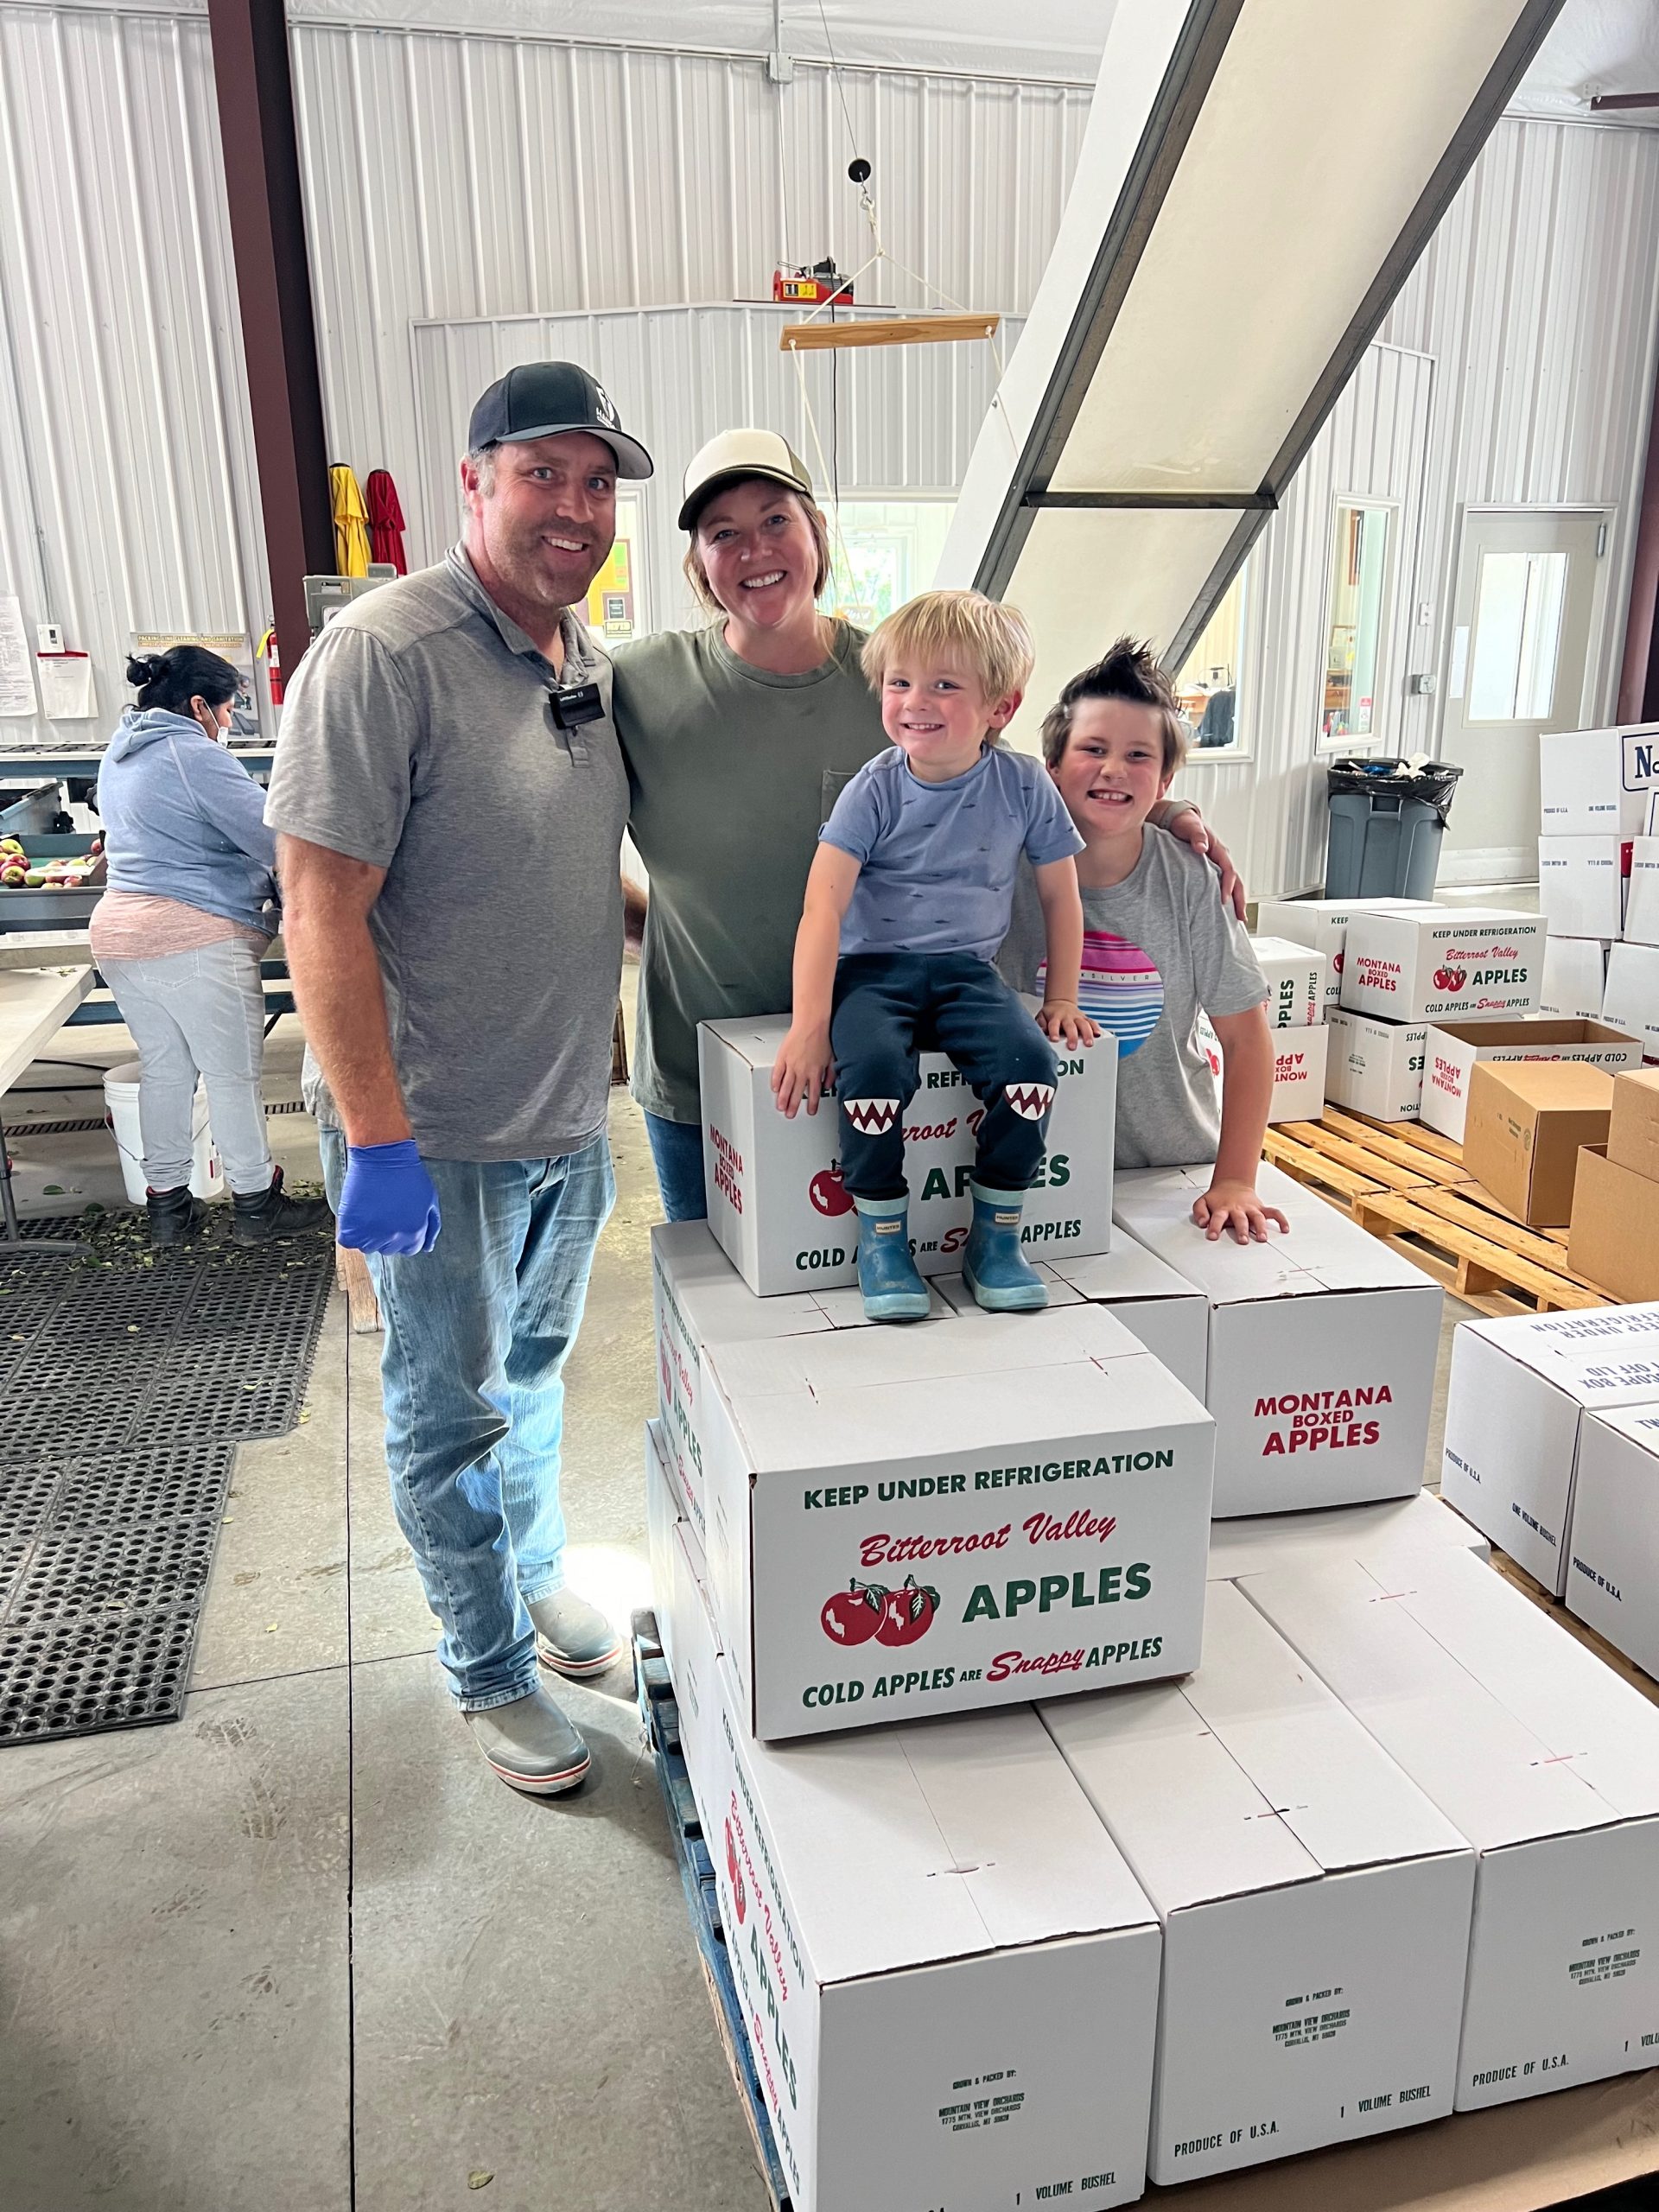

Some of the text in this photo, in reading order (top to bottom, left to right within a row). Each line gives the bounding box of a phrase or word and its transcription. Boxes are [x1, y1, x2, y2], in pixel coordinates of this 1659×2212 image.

[1433, 926, 1536, 938] KEEP UNDER REFRIGERATION
[1357, 957, 1401, 973] MONTANA
[1446, 946, 1519, 961] Bitterroot Valley
[1358, 974, 1397, 992] APPLES
[1368, 969, 1388, 978] BOXED
[1472, 968, 1528, 985] APPLES
[1308, 972, 1317, 1001] APPLES
[1425, 1004, 1443, 1013] COLD
[1445, 1002, 1469, 1011] APPLES
[1506, 998, 1530, 1007] APPLES
[1435, 1057, 1461, 1079] APPLES
[1572, 1053, 1603, 1063] APPLES
[1605, 1053, 1627, 1062] COLD
[1432, 1074, 1462, 1098] MONTANA
[710, 1123, 744, 1176] MONTANA
[715, 1162, 743, 1214] APPLES
[795, 1248, 845, 1271] COLD
[920, 1241, 938, 1252] ARE
[1021, 1219, 1082, 1244] APPLES
[1578, 1378, 1618, 1389] BOX
[1254, 1385, 1392, 1417] MONTANA
[1293, 1410, 1354, 1428] BOXED
[1262, 1421, 1380, 1456] APPLES
[1446, 1448, 1463, 1469] PRODUCE
[1463, 1462, 1469, 1472] OF
[804, 1449, 1174, 1510] KEEP UNDER REFRIGERATION
[860, 1508, 1117, 1567] Bitterroot Valley
[1512, 1503, 1557, 1548] ONE VOLUME BUSHEL
[1573, 1556, 1622, 1602] PRODUCE OF U.S.A.
[961, 1562, 1152, 1624] APPLES
[802, 1637, 1163, 1709] COLD APPLES ARE Snappy APPLES
[735, 1750, 754, 1822] UNDER
[754, 1814, 805, 1991] REFRIGERATION
[1598, 1956, 1611, 1966] VIEW
[750, 1923, 797, 2111] APPLES
[1272, 2009, 1350, 2034] MOUNTAIN VIEW ORCHARDS
[1305, 2026, 1318, 2034] VIEW
[982, 2072, 1004, 2083] PACKED
[1006, 2069, 1017, 2078] BY:
[1472, 2054, 1569, 2087] PRODUCE OF U.S.A.
[938, 2092, 1025, 2117] MOUNTAIN VIEW ORCHARDS
[942, 2117, 956, 2125] 1775
[975, 2110, 989, 2118] VIEW
[991, 2103, 1021, 2115] ORCHARDS
[1340, 2085, 1431, 2119] 1 VOLUME BUSHEL
[778, 2107, 800, 2196] APPLES
[1174, 2120, 1280, 2158] PRODUCE OF U.S.A.
[1016, 2171, 1116, 2206] 1 VOLUME BUSHEL
